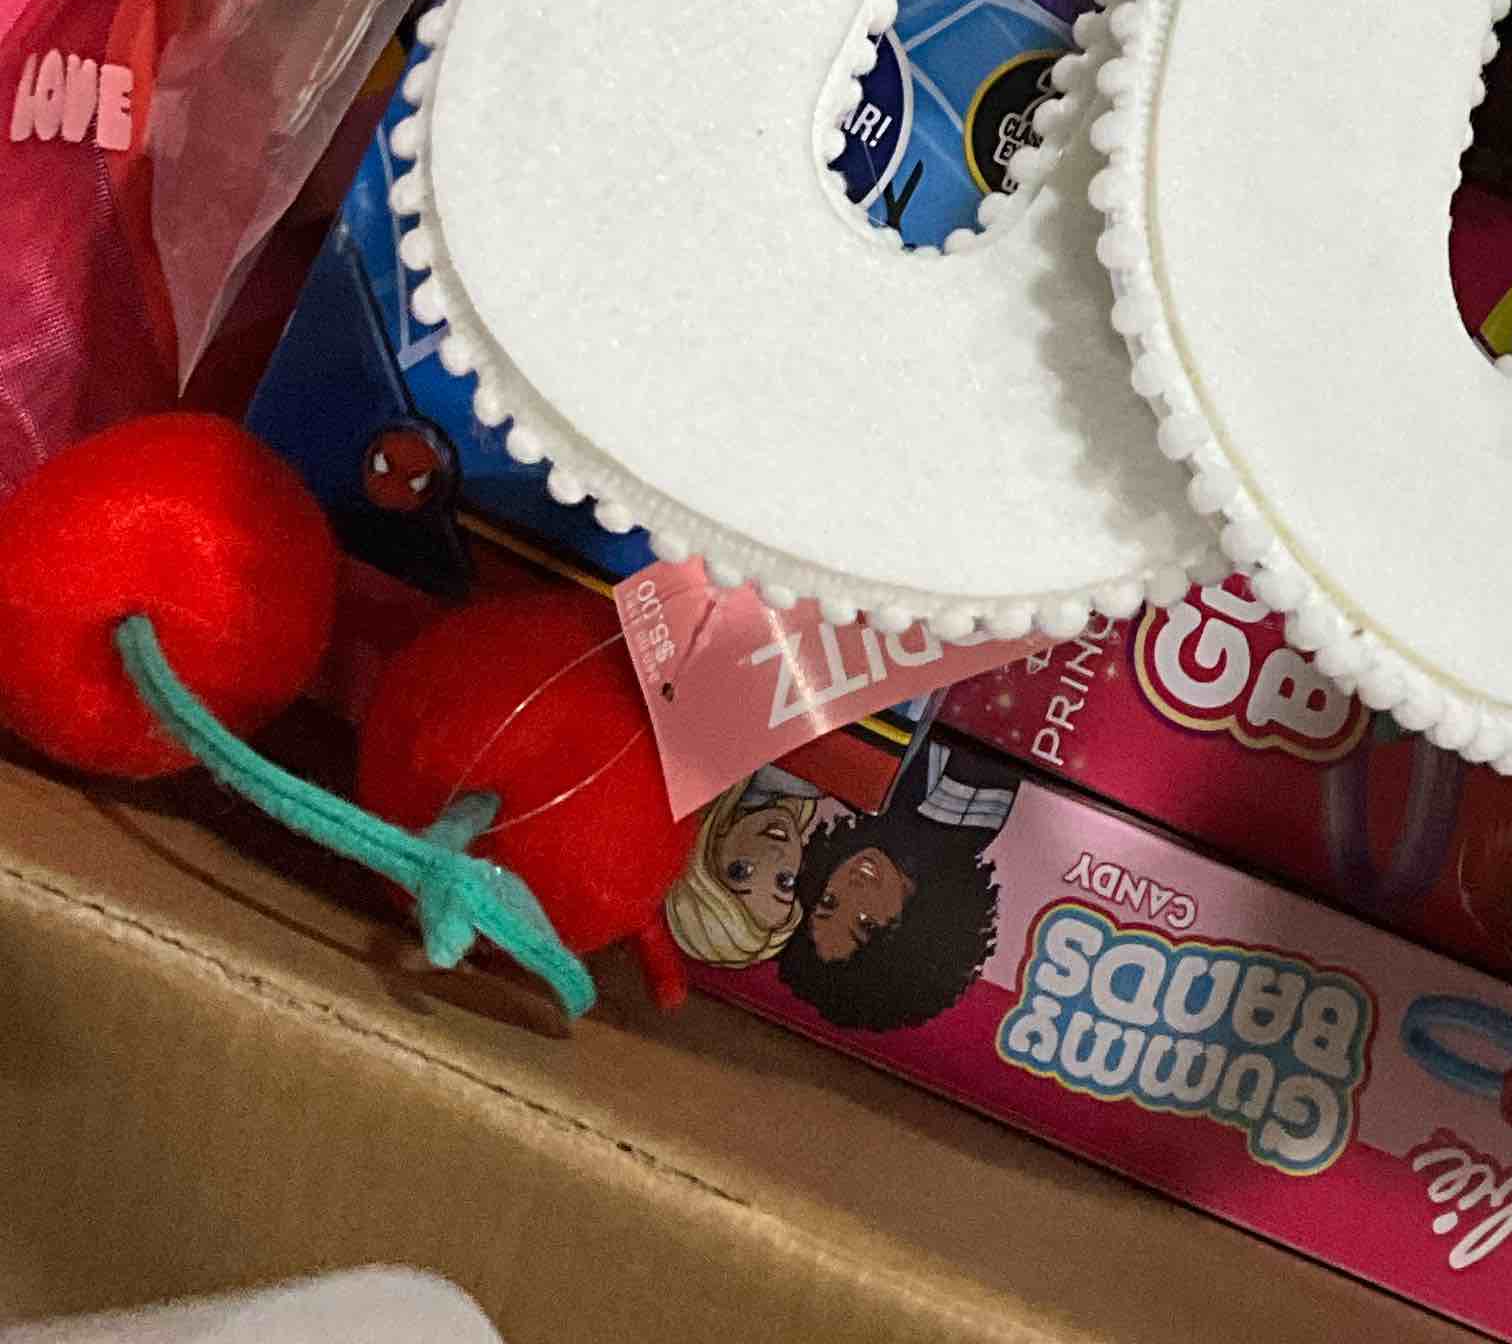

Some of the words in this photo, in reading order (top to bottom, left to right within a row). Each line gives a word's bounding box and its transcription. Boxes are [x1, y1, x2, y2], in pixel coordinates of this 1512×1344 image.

[10, 48, 134, 151] LOVE
[637, 579, 675, 663] $5.00
[1064, 853, 1198, 930] CANDY
